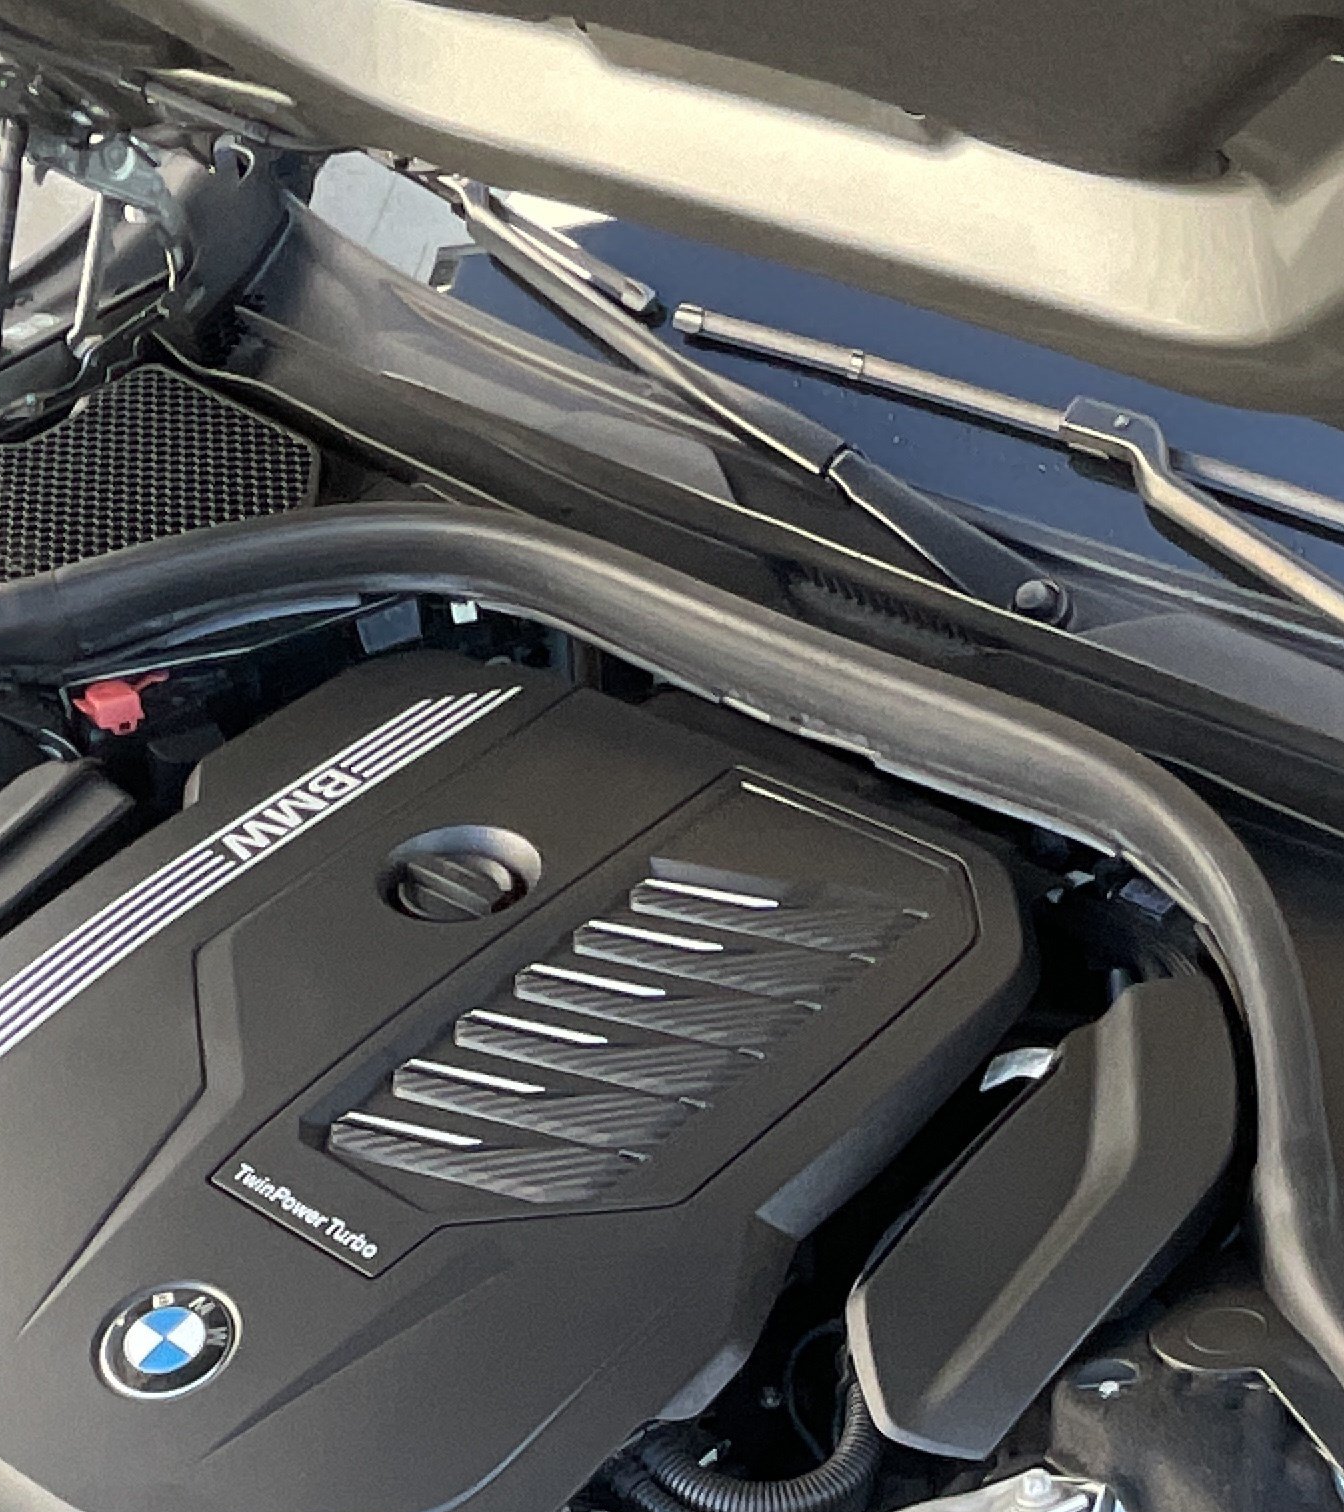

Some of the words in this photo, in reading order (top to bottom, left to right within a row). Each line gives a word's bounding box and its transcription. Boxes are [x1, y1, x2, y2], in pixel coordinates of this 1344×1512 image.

[221, 768, 362, 861] BMW
[234, 1162, 330, 1228] TwinPower
[324, 1216, 378, 1259] Turbo
[152, 1291, 228, 1346] BMW
